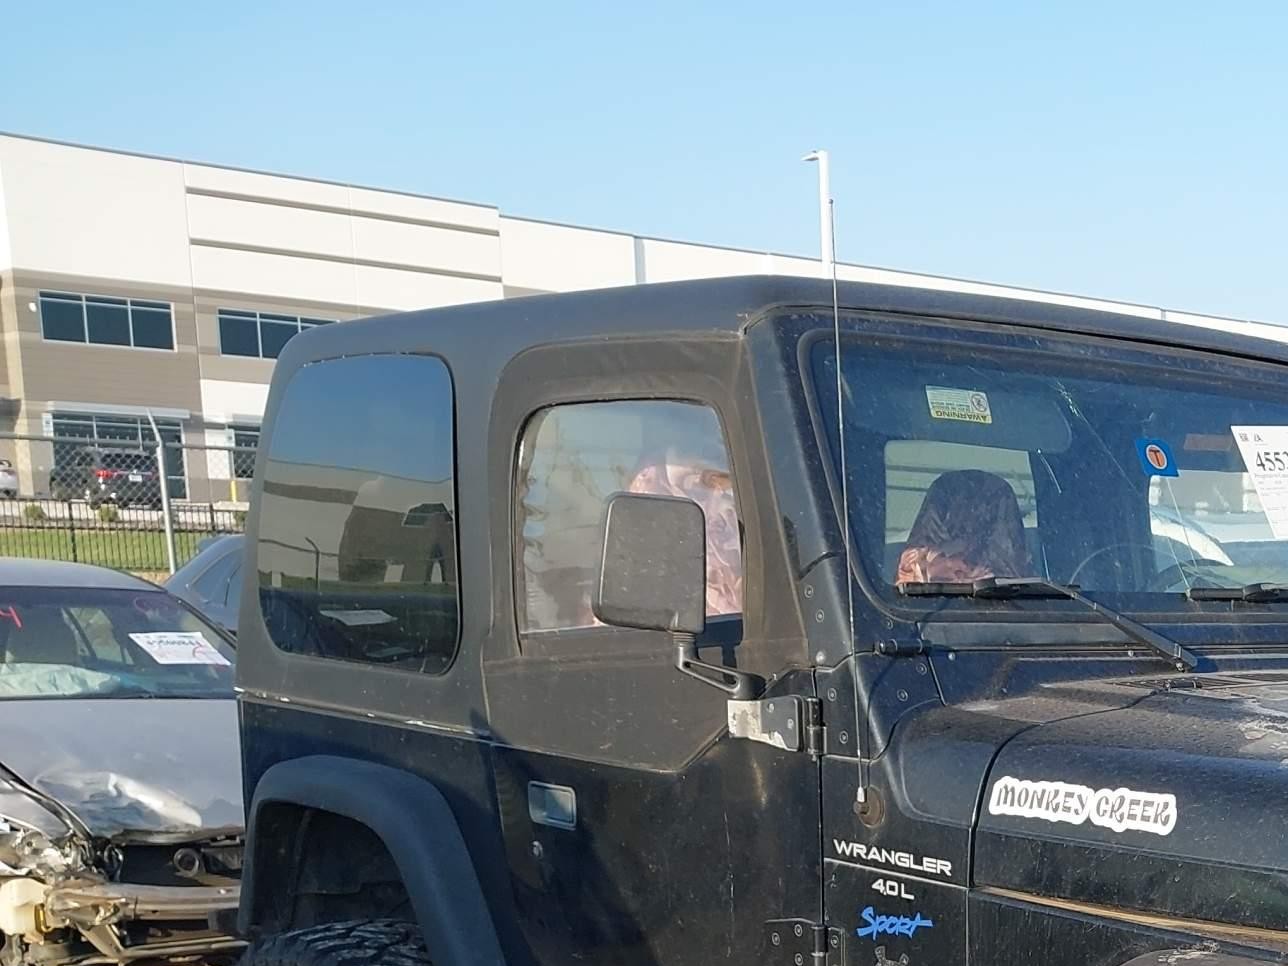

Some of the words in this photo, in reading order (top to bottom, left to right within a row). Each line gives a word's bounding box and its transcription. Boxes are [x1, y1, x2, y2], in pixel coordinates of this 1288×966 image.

[996, 783, 1089, 816] MONKEY
[1095, 795, 1171, 827] CREEK
[833, 839, 952, 876] WRANGLER
